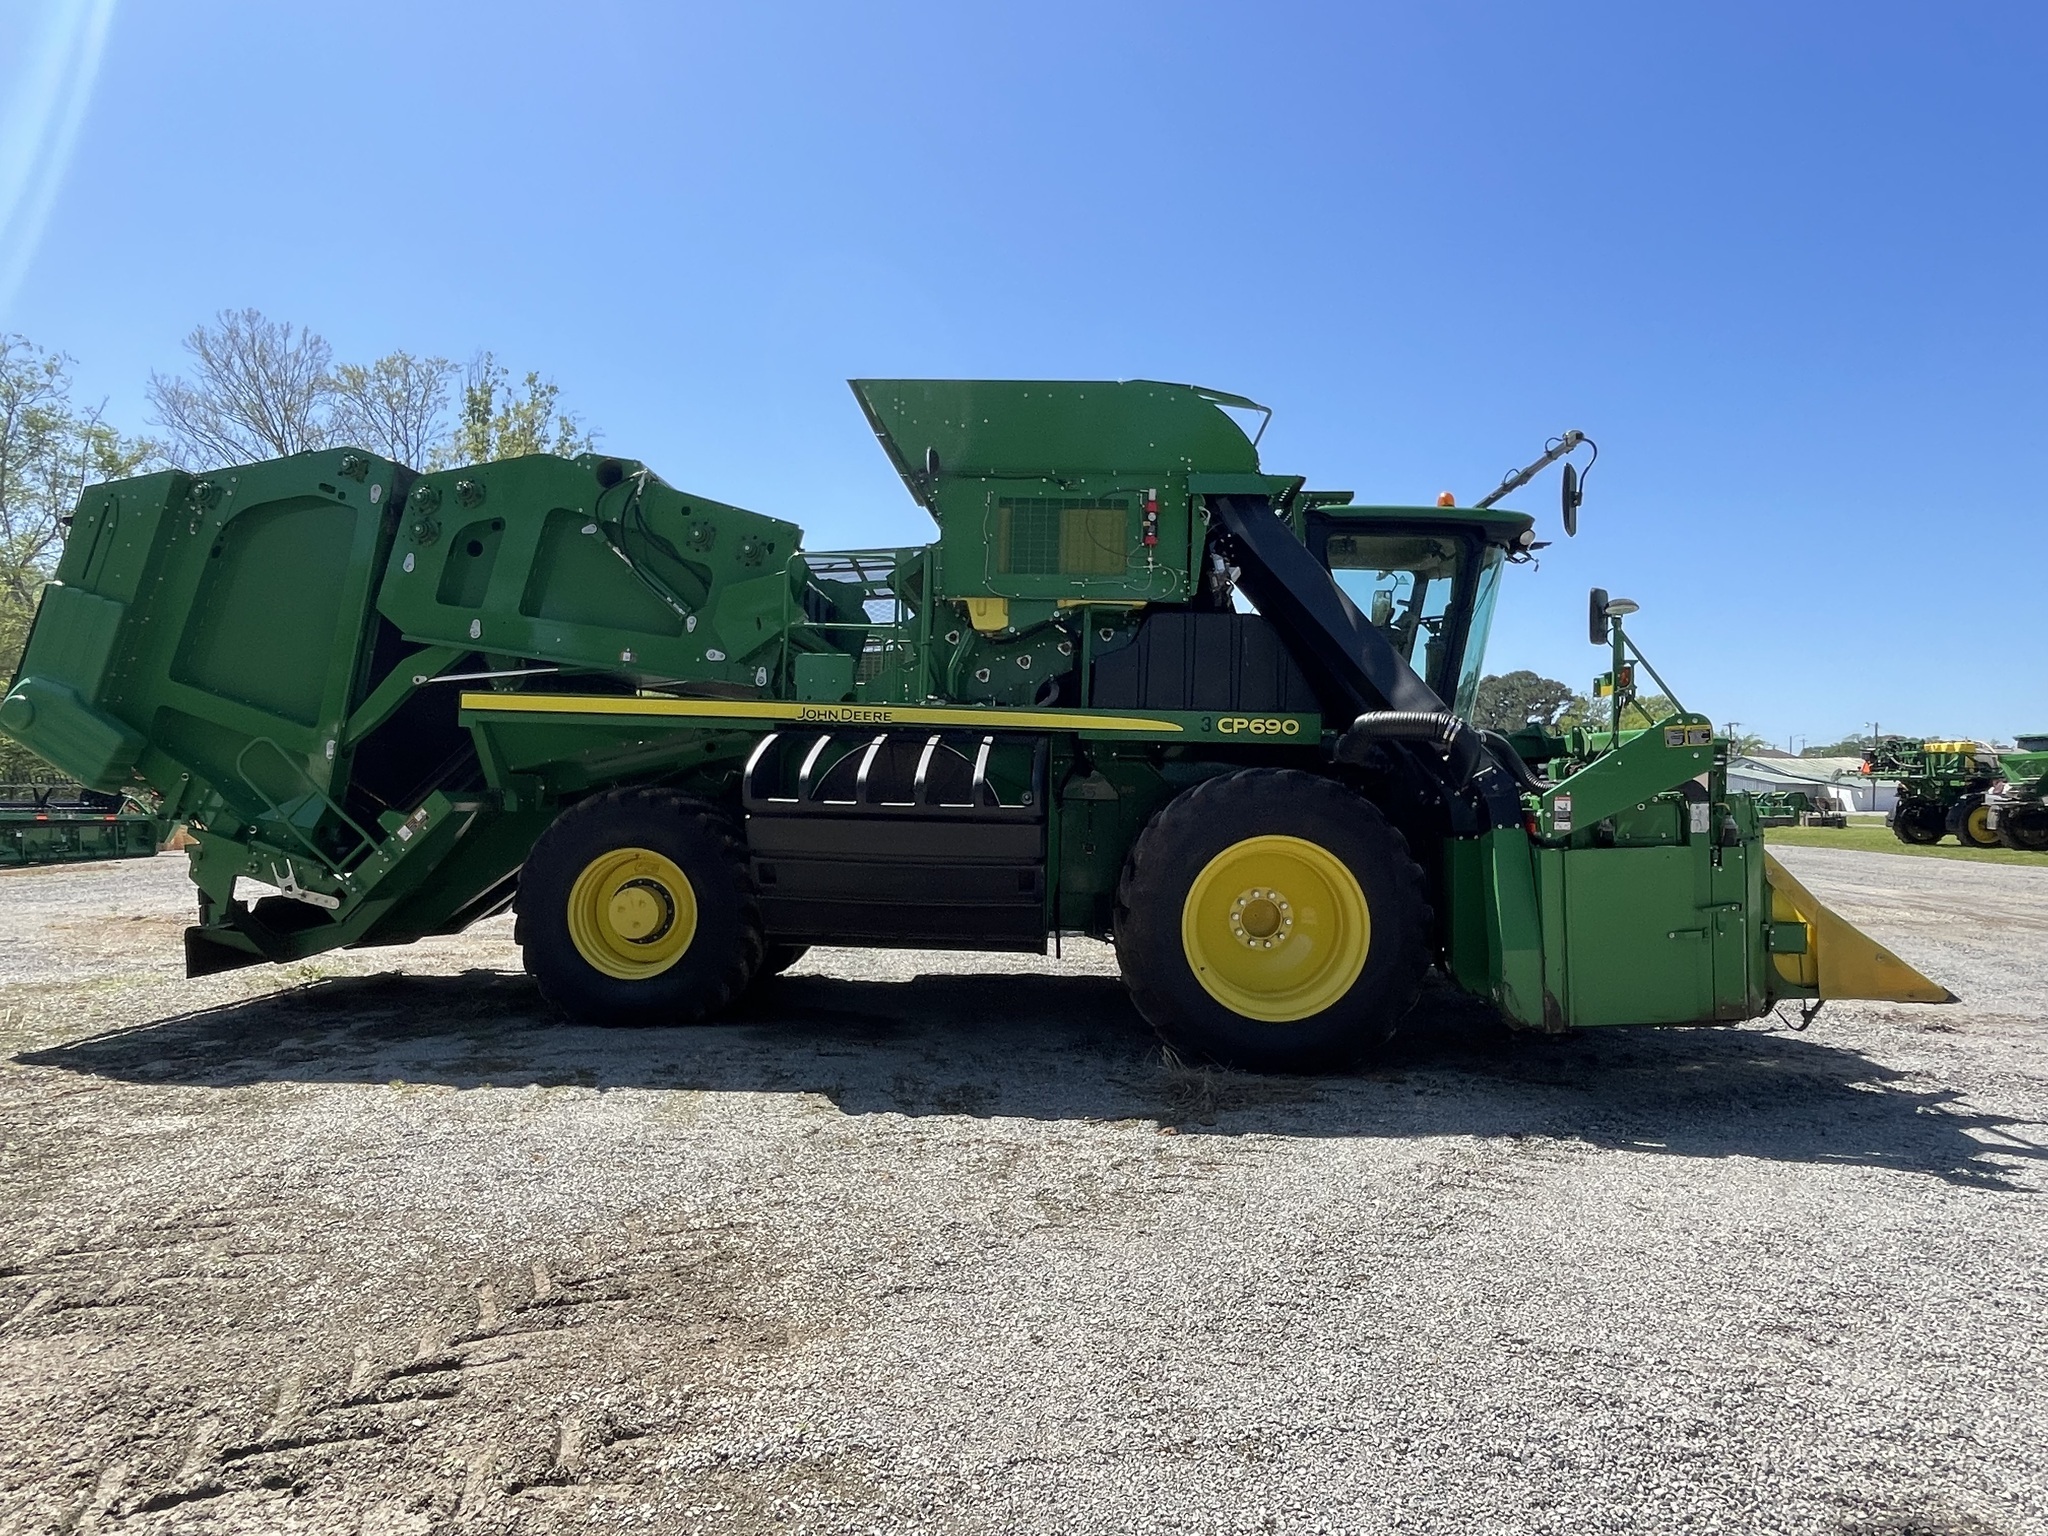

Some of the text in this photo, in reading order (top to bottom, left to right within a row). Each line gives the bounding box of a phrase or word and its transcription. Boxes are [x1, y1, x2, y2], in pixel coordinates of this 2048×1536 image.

[797, 707, 892, 722] JOHN DEERE
[1200, 716, 1212, 732] 3
[1217, 717, 1300, 735] CP690
